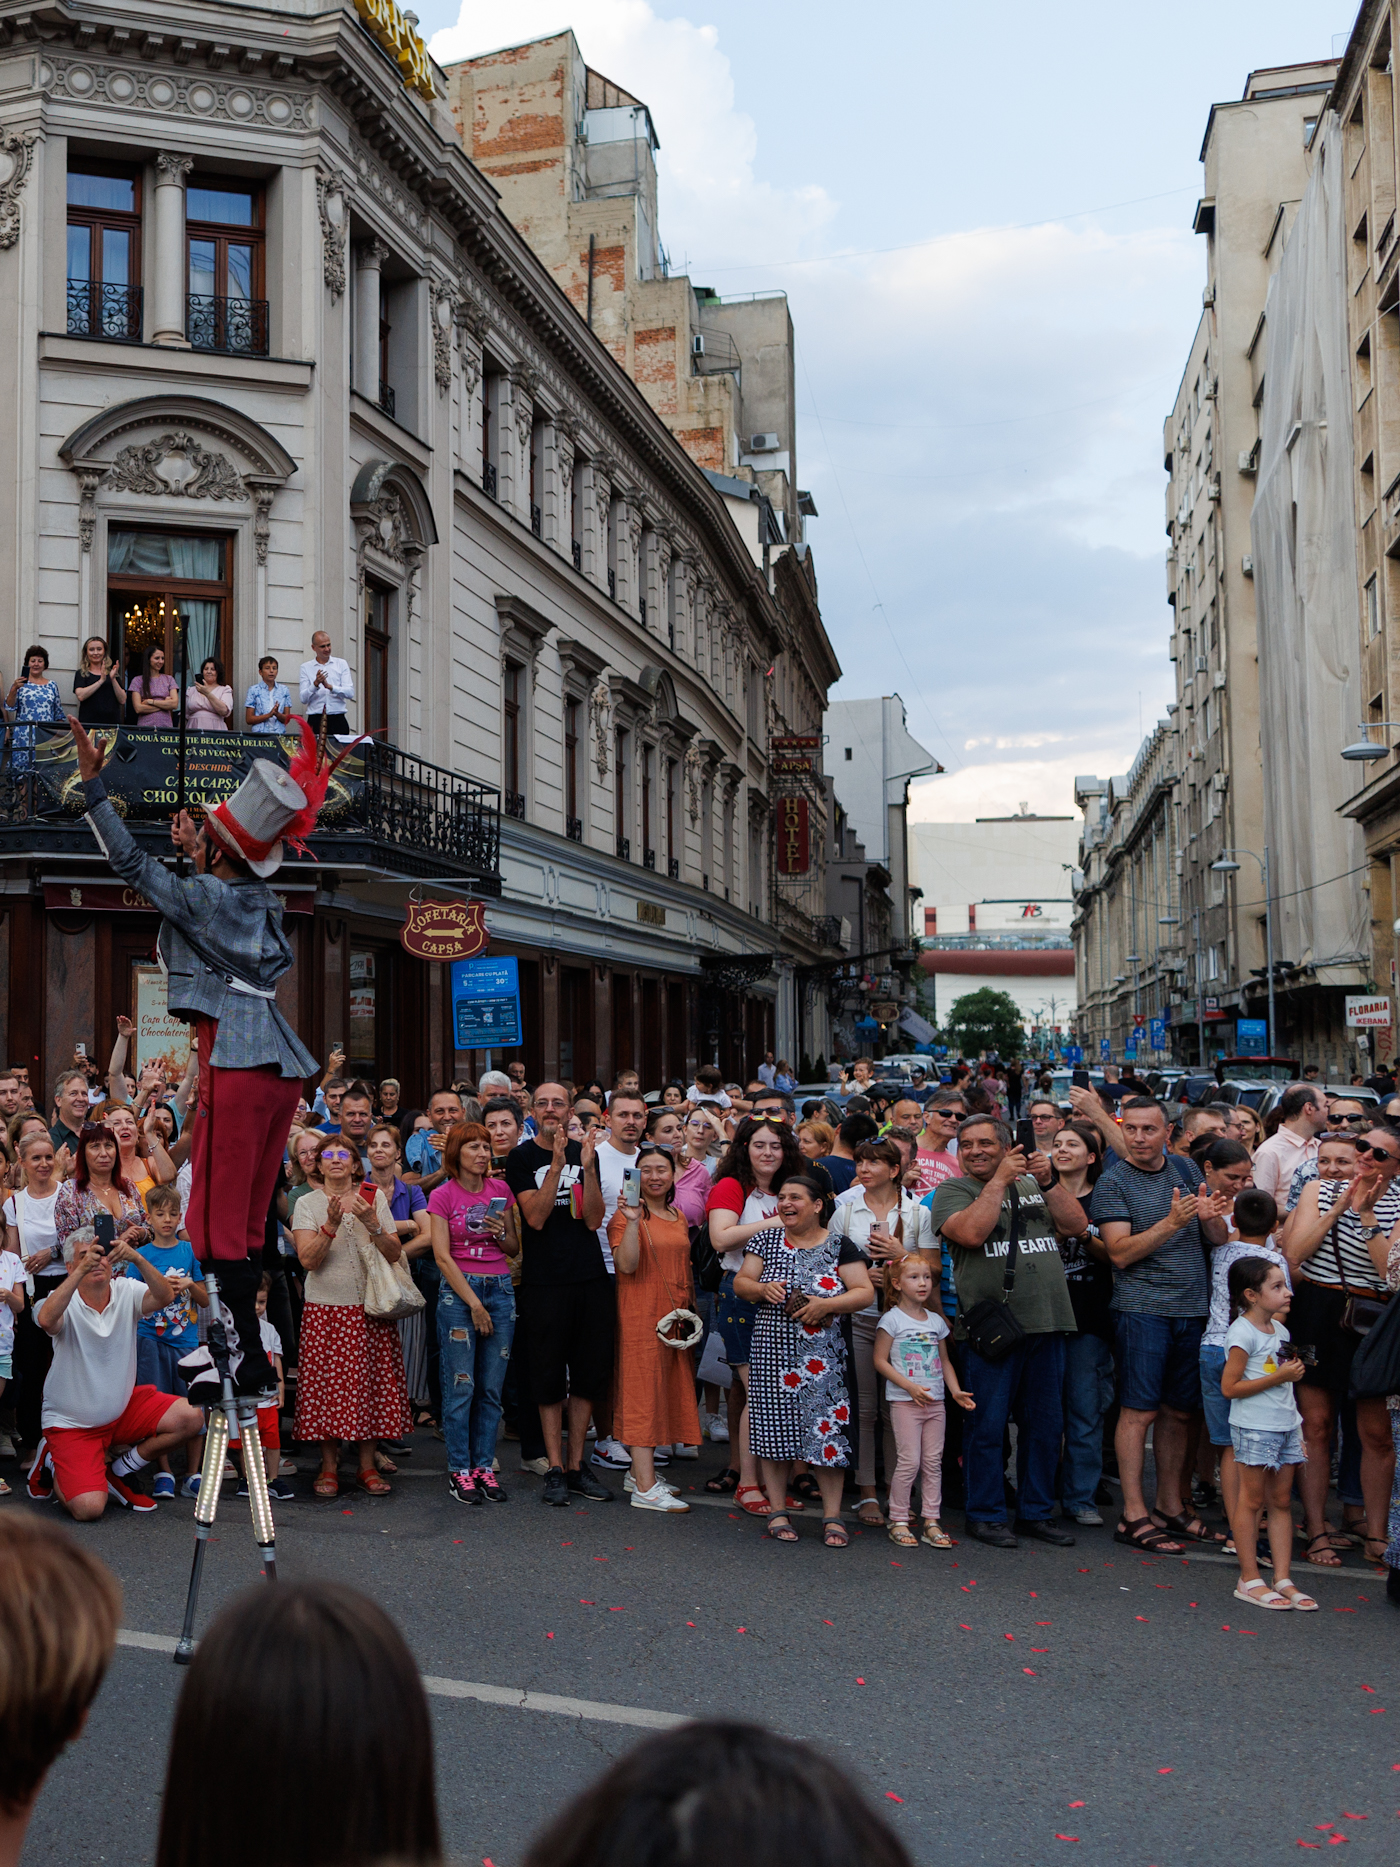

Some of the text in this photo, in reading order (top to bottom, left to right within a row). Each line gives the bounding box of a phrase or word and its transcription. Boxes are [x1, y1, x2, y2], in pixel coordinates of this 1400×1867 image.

[127, 734, 135, 742] O
[136, 733, 159, 743] NOUĂ
[159, 735, 199, 746] SELEȚIE
[200, 736, 241, 747] BELGIANĂ
[208, 747, 242, 758] VEGANĂ
[188, 763, 233, 773] DESCHIDE
[784, 798, 800, 873] HOTEL
[411, 908, 477, 936] COFETARIA
[1018, 1236, 1059, 1255] EARTH
